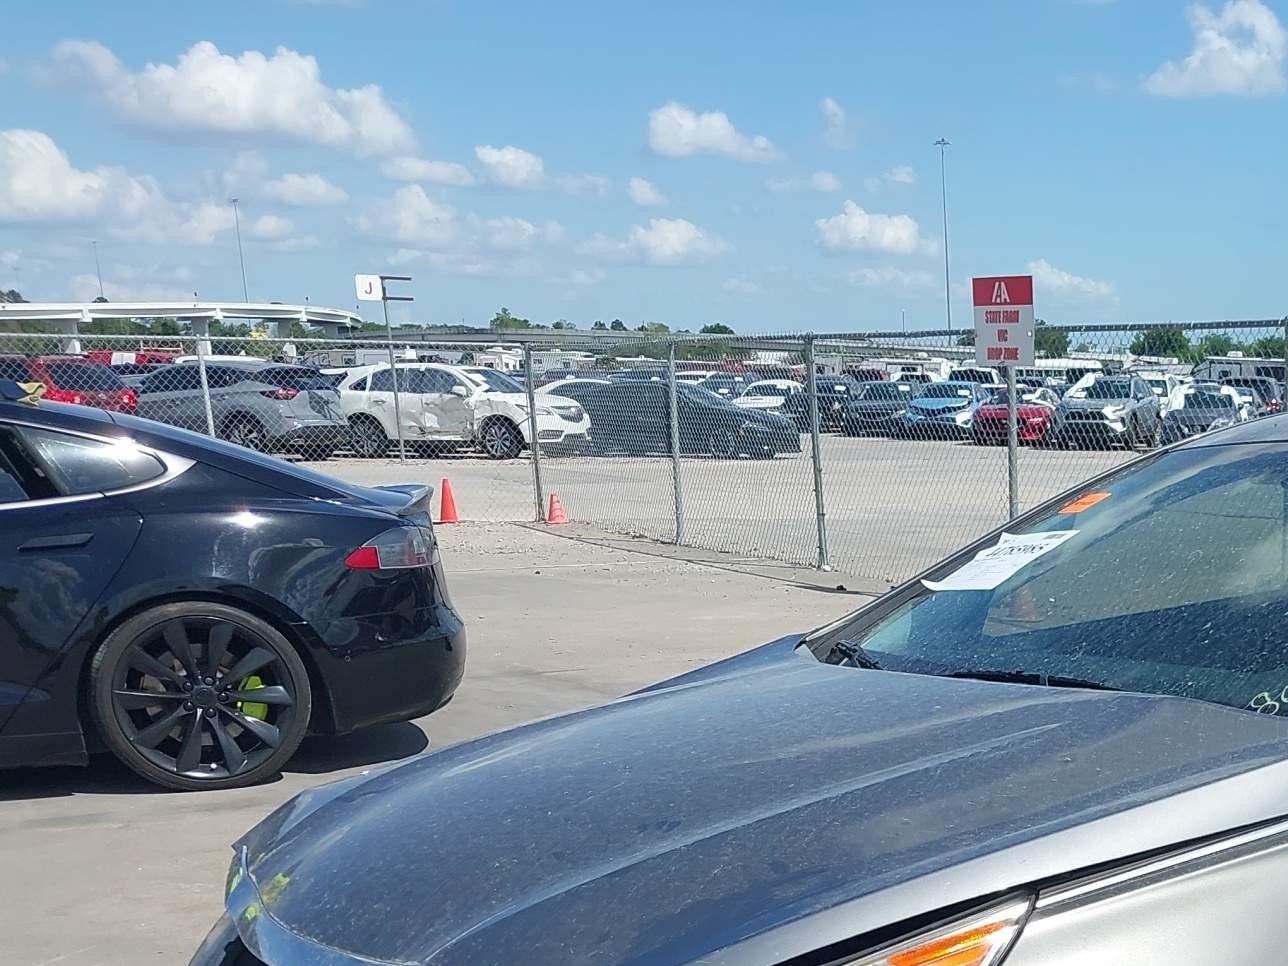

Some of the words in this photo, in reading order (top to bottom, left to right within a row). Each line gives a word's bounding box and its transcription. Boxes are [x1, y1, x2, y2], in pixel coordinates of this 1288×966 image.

[364, 281, 373, 295] J
[985, 311, 1002, 323] STATE
[1003, 347, 1019, 360] ZONE
